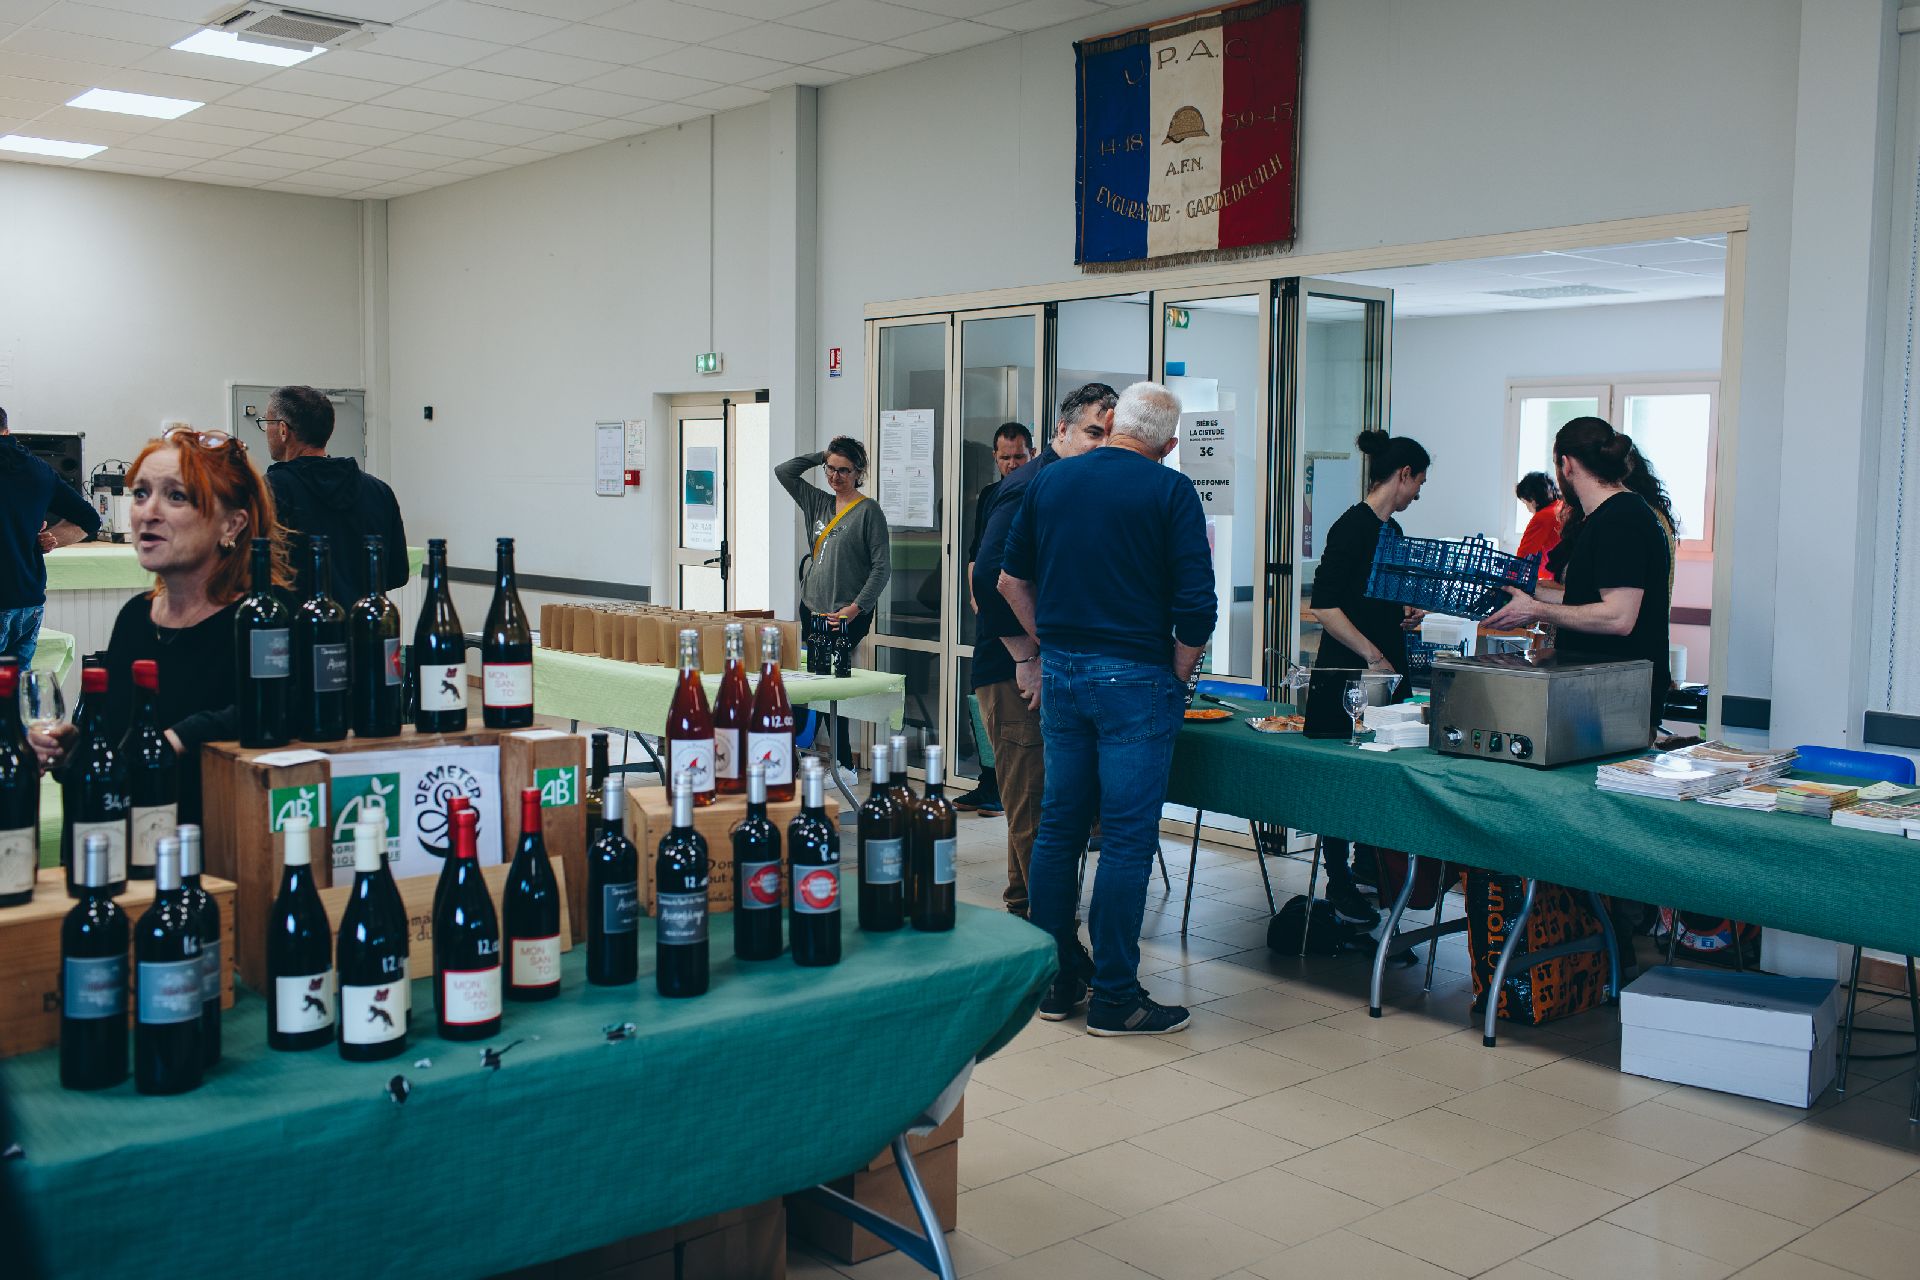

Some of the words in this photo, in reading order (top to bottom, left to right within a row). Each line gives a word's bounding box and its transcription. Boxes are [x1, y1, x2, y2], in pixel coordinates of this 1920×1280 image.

[1199, 446, 1214, 457] 3€
[414, 764, 483, 805] DEMETER
[540, 779, 571, 806] AB
[1487, 880, 1505, 942] TOUT
